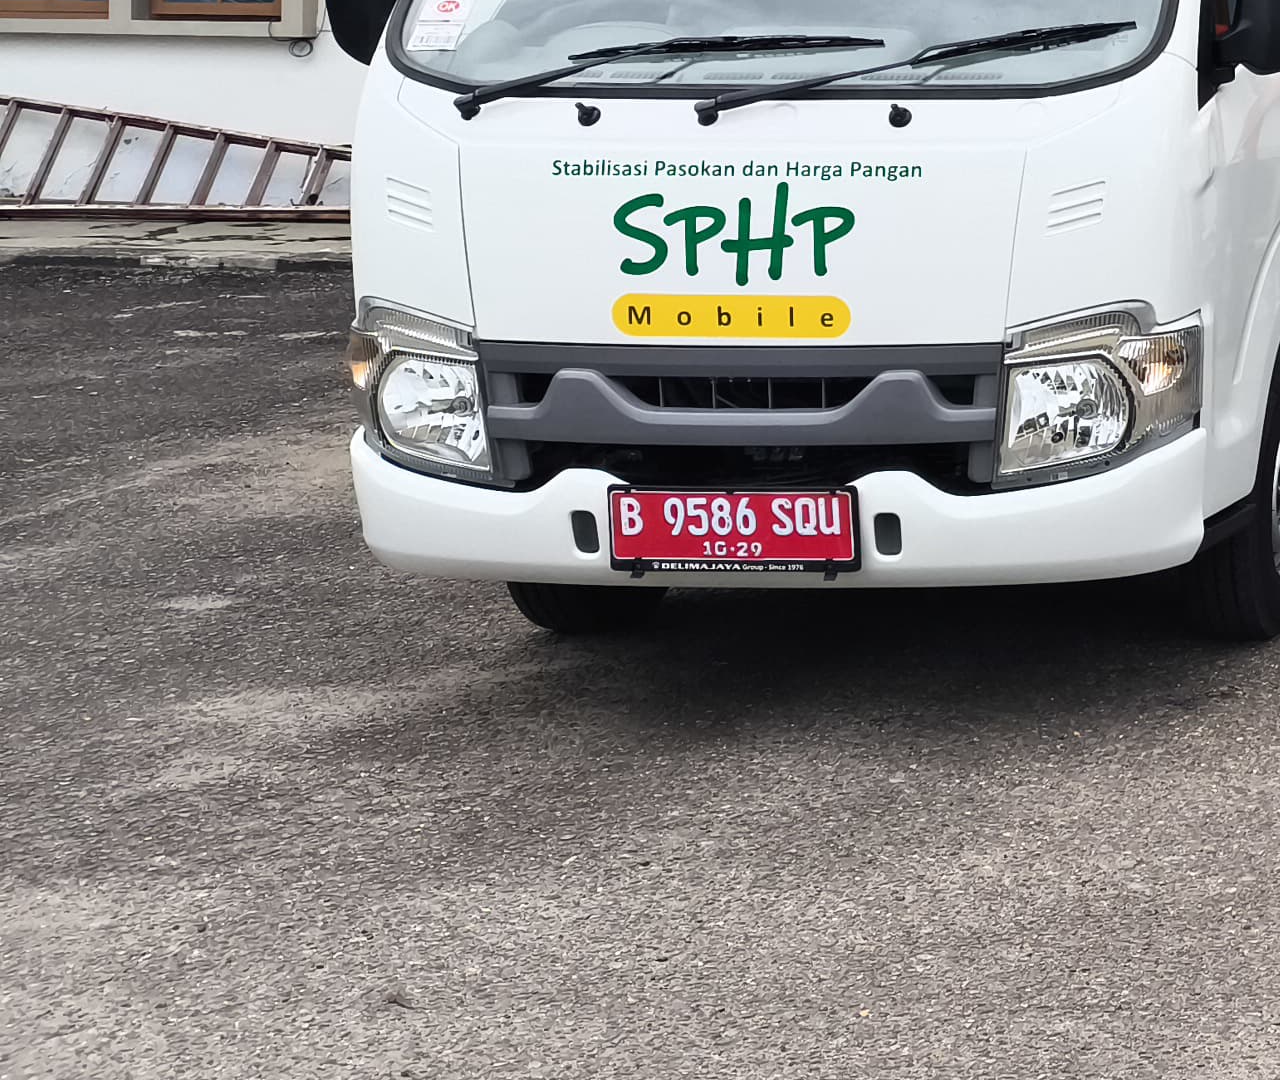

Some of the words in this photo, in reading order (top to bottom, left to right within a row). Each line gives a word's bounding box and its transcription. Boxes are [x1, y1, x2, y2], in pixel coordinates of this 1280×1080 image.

[438, 1, 459, 12] OK
[552, 159, 649, 177] Stabilisasi
[654, 160, 736, 177] Pasokan
[742, 161, 779, 177] dan
[786, 162, 843, 180] Harga
[850, 162, 923, 181] Pangan
[613, 181, 856, 286] SPHP
[627, 305, 834, 328] Mobile
[619, 497, 644, 536] B
[663, 497, 757, 536] 9586
[771, 497, 841, 536] SQU
[661, 562, 741, 570] DELIMAJAYA
